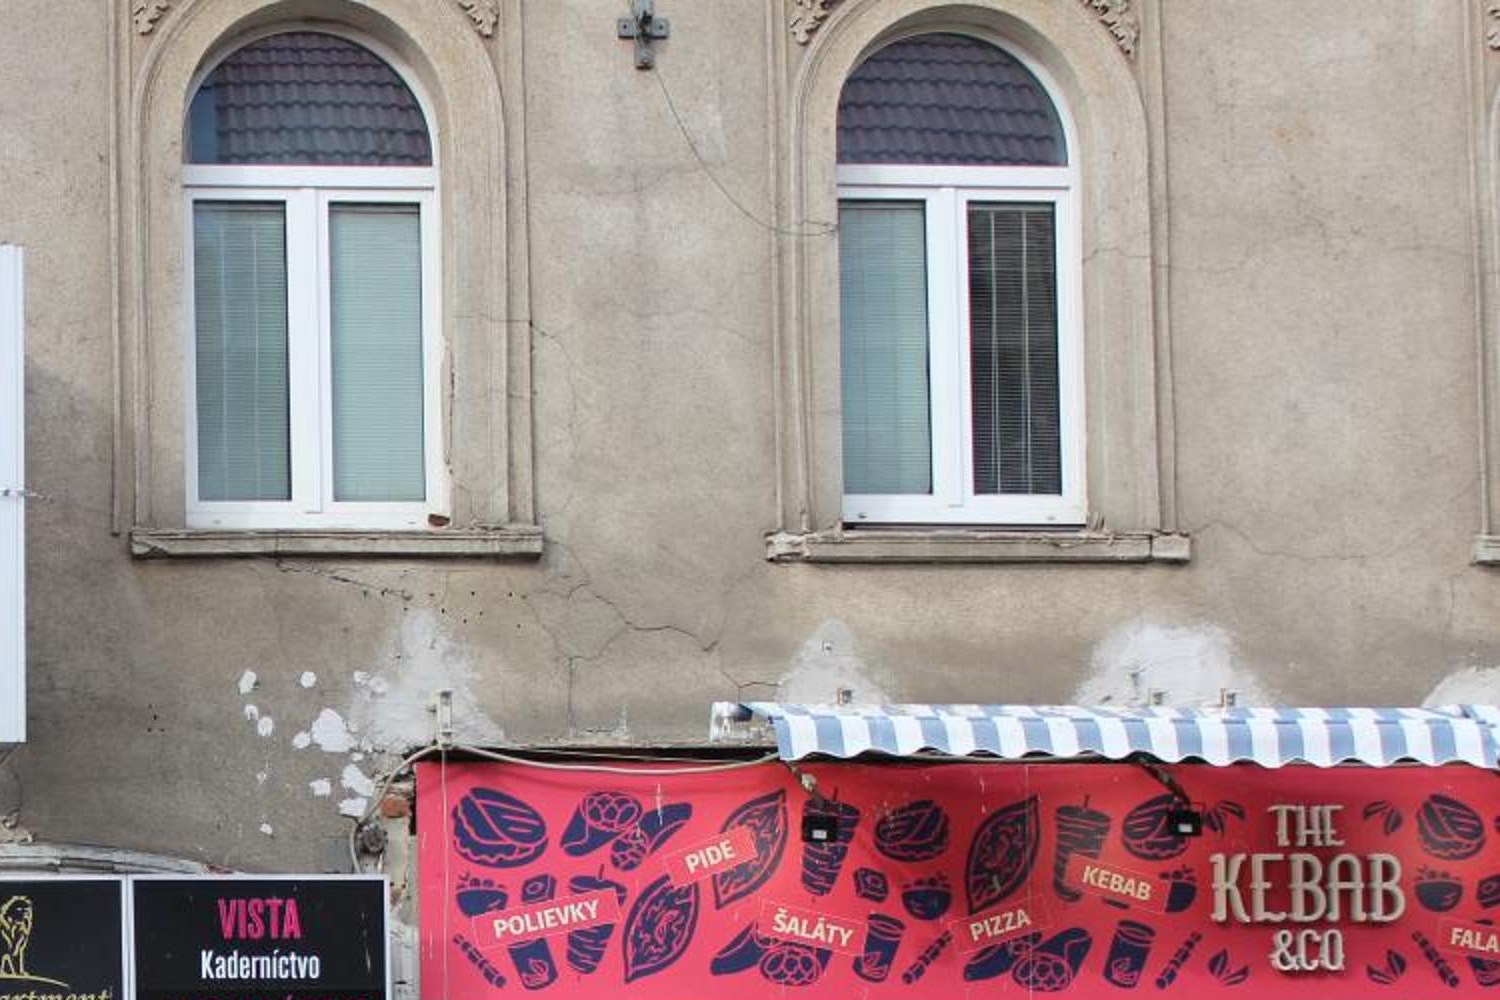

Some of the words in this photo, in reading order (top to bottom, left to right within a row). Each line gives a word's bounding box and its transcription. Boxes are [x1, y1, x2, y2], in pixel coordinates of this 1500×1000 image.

[1268, 804, 1345, 847] THE
[685, 839, 735, 873] PIDE
[1082, 864, 1152, 901] KEBAB
[1210, 853, 1405, 924] KEBAB
[217, 898, 301, 939] VISTA
[493, 900, 599, 938] POLIEVKY
[771, 908, 855, 947] ŠALÁTY
[969, 909, 1032, 941] PIZZA
[201, 949, 320, 979] Kaderníctvo
[1269, 928, 1345, 971] &CO
